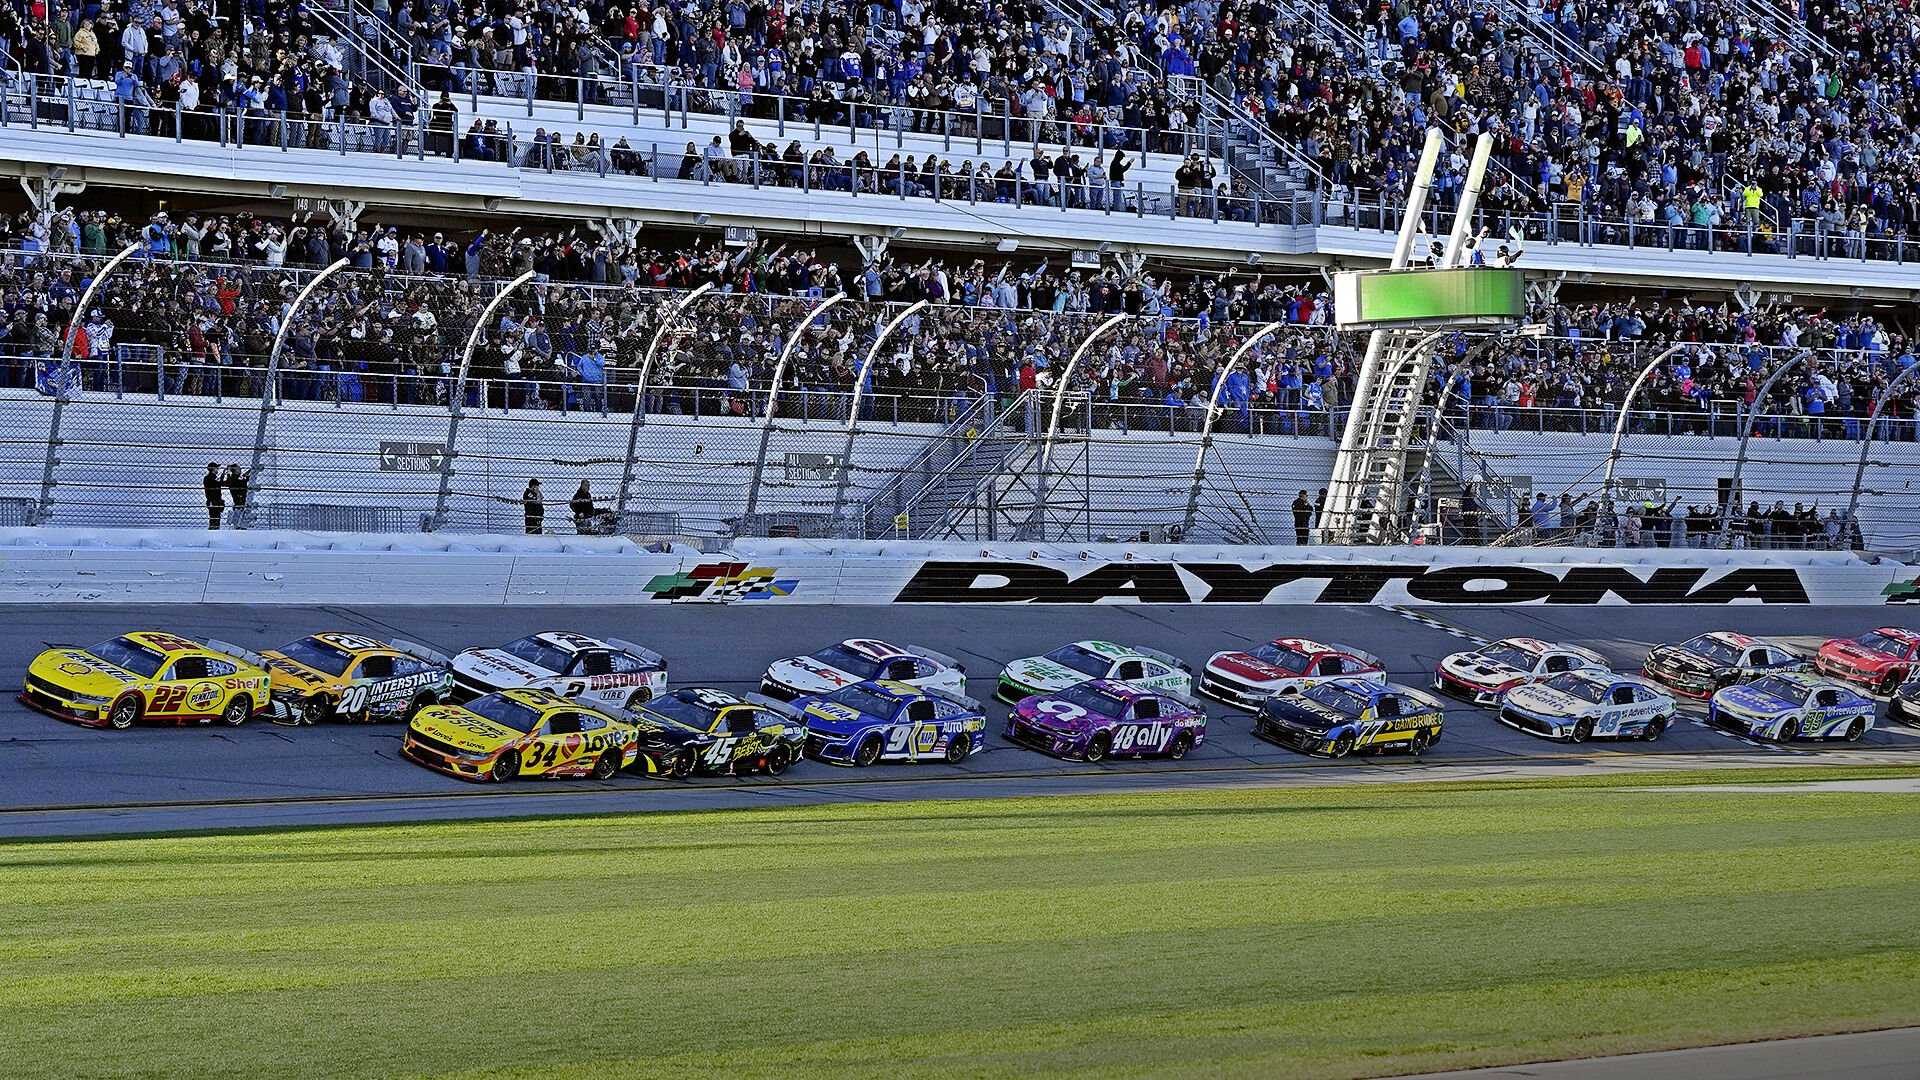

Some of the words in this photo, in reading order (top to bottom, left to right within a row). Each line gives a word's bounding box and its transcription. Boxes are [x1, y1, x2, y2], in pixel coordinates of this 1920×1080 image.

[297, 198, 309, 210] 148
[317, 199, 328, 211] 147
[397, 456, 431, 471] SECTIONS
[788, 469, 821, 480] SECTIONS
[893, 561, 1810, 604] DAYTONA
[225, 678, 260, 690] Shell
[370, 671, 439, 696] INTERSTATE
[563, 681, 586, 698] 2
[590, 671, 654, 691] DISCOUNT
[147, 685, 188, 713] 22
[335, 685, 369, 714] 20
[369, 687, 415, 704] BATTERIES
[602, 691, 623, 699] TIRE
[1516, 689, 1565, 711] Health
[1523, 685, 1576, 706] Advent
[942, 721, 963, 733] AUTO
[1394, 714, 1438, 731] GAINBRIDGE
[1598, 710, 1622, 733] 43
[1802, 709, 1826, 733] 99
[886, 726, 912, 752] 9
[1113, 725, 1138, 750] 48
[1137, 720, 1173, 752] ally
[1353, 720, 1386, 751] 77
[525, 741, 560, 768] 34
[704, 737, 738, 765] 45
